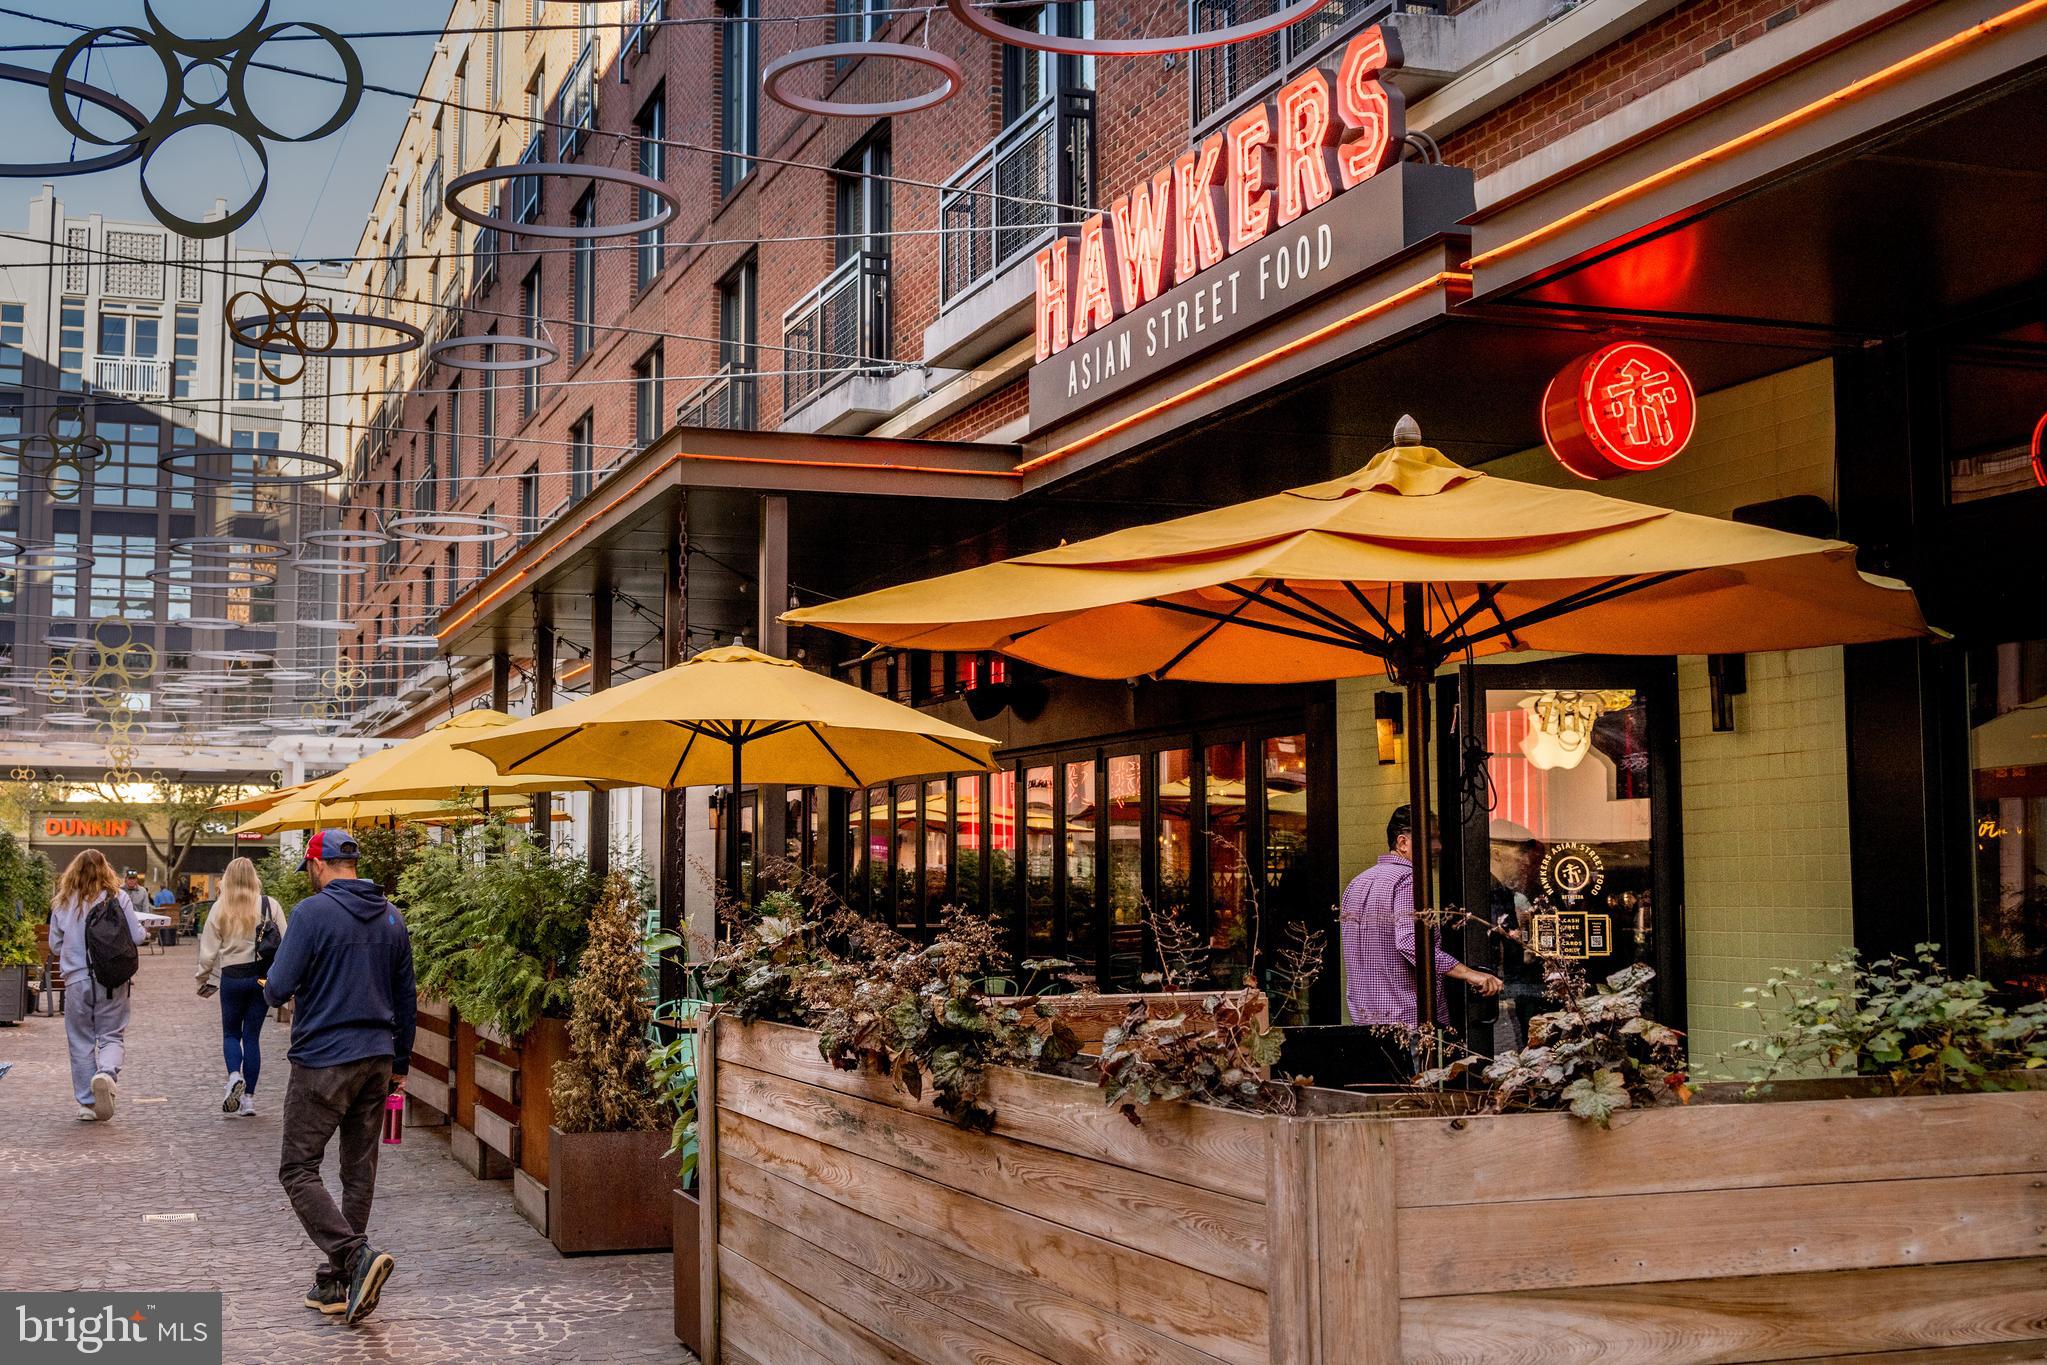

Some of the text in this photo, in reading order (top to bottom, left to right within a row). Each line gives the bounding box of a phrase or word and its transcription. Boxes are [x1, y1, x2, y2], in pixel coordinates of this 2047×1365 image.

[1036, 24, 1392, 364] HAWKERS
[1068, 224, 1333, 398] ASIAN STREET FOOD
[1551, 842, 1577, 855] ASIAN
[1579, 844, 1604, 871] STREET
[1540, 854, 1554, 896] HAWKERS
[1591, 874, 1605, 896] FOOD
